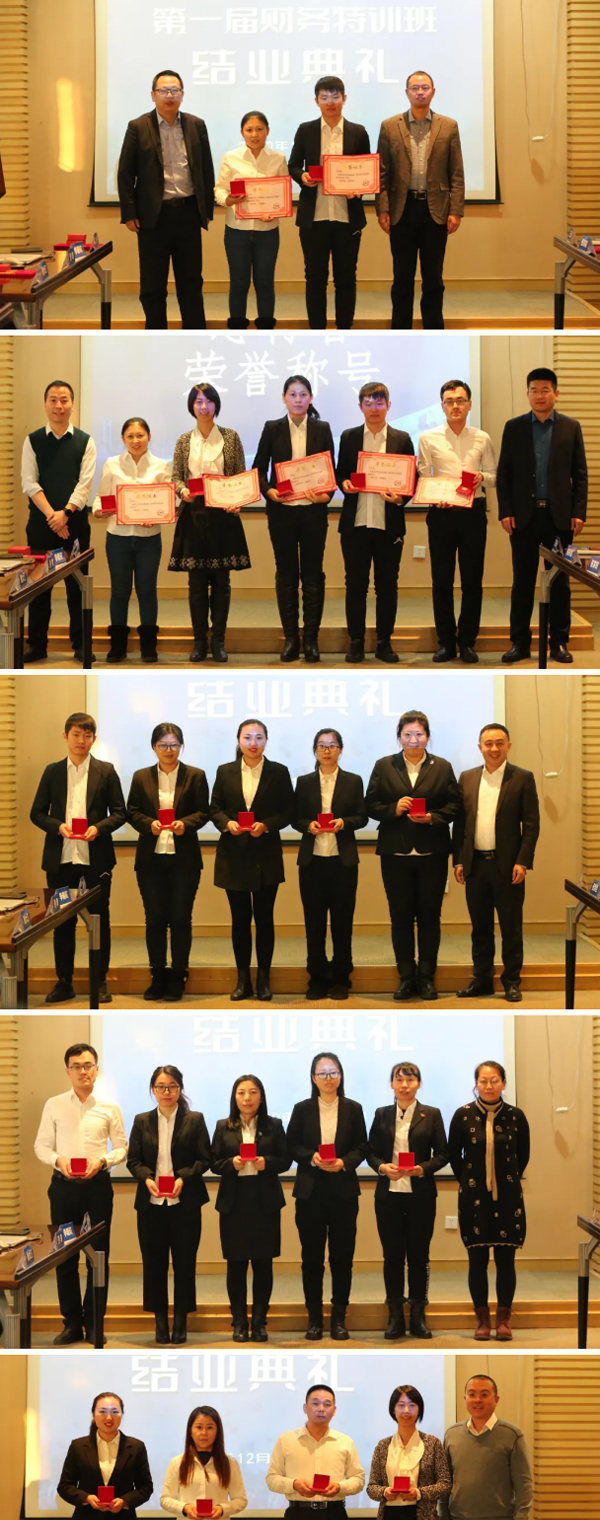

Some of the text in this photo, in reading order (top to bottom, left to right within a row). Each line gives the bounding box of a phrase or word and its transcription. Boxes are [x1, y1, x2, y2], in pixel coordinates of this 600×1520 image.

[153, 6, 438, 35] 第一届财务特训班
[192, 48, 399, 85] 结业典礼
[182, 349, 381, 399] 荣誉称号
[187, 679, 405, 718] 结业典礼
[192, 1015, 414, 1054] 结业典礼
[131, 1355, 354, 1392] 结业典礼
[227, 1453, 270, 1465] 12月
